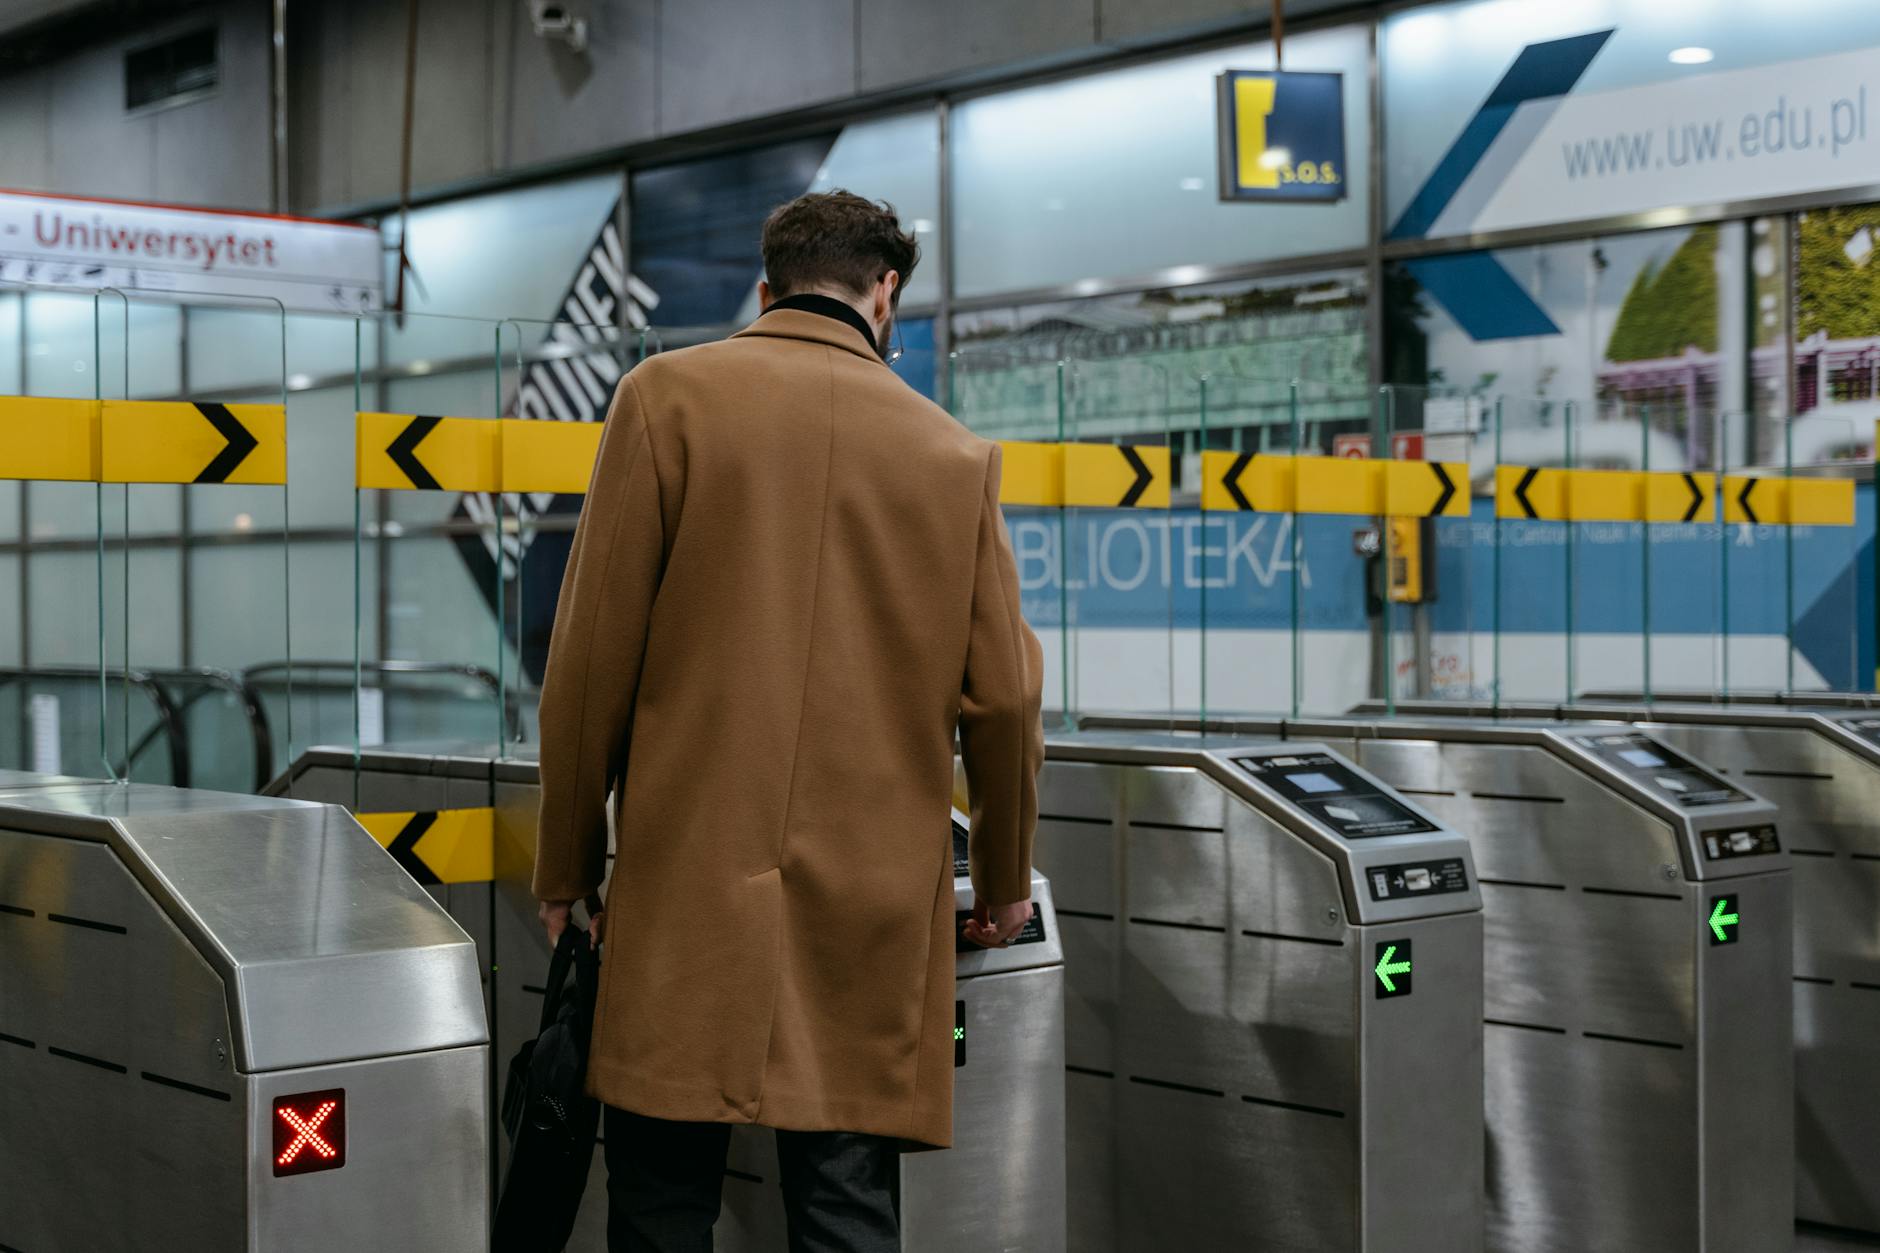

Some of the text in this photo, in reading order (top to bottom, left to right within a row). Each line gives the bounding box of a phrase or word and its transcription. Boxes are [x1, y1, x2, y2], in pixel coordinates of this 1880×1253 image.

[1562, 84, 1866, 180] www.uw.edu.pl
[35, 211, 278, 271] Uniwersytet
[1006, 513, 1312, 590] BLIOTEKA
